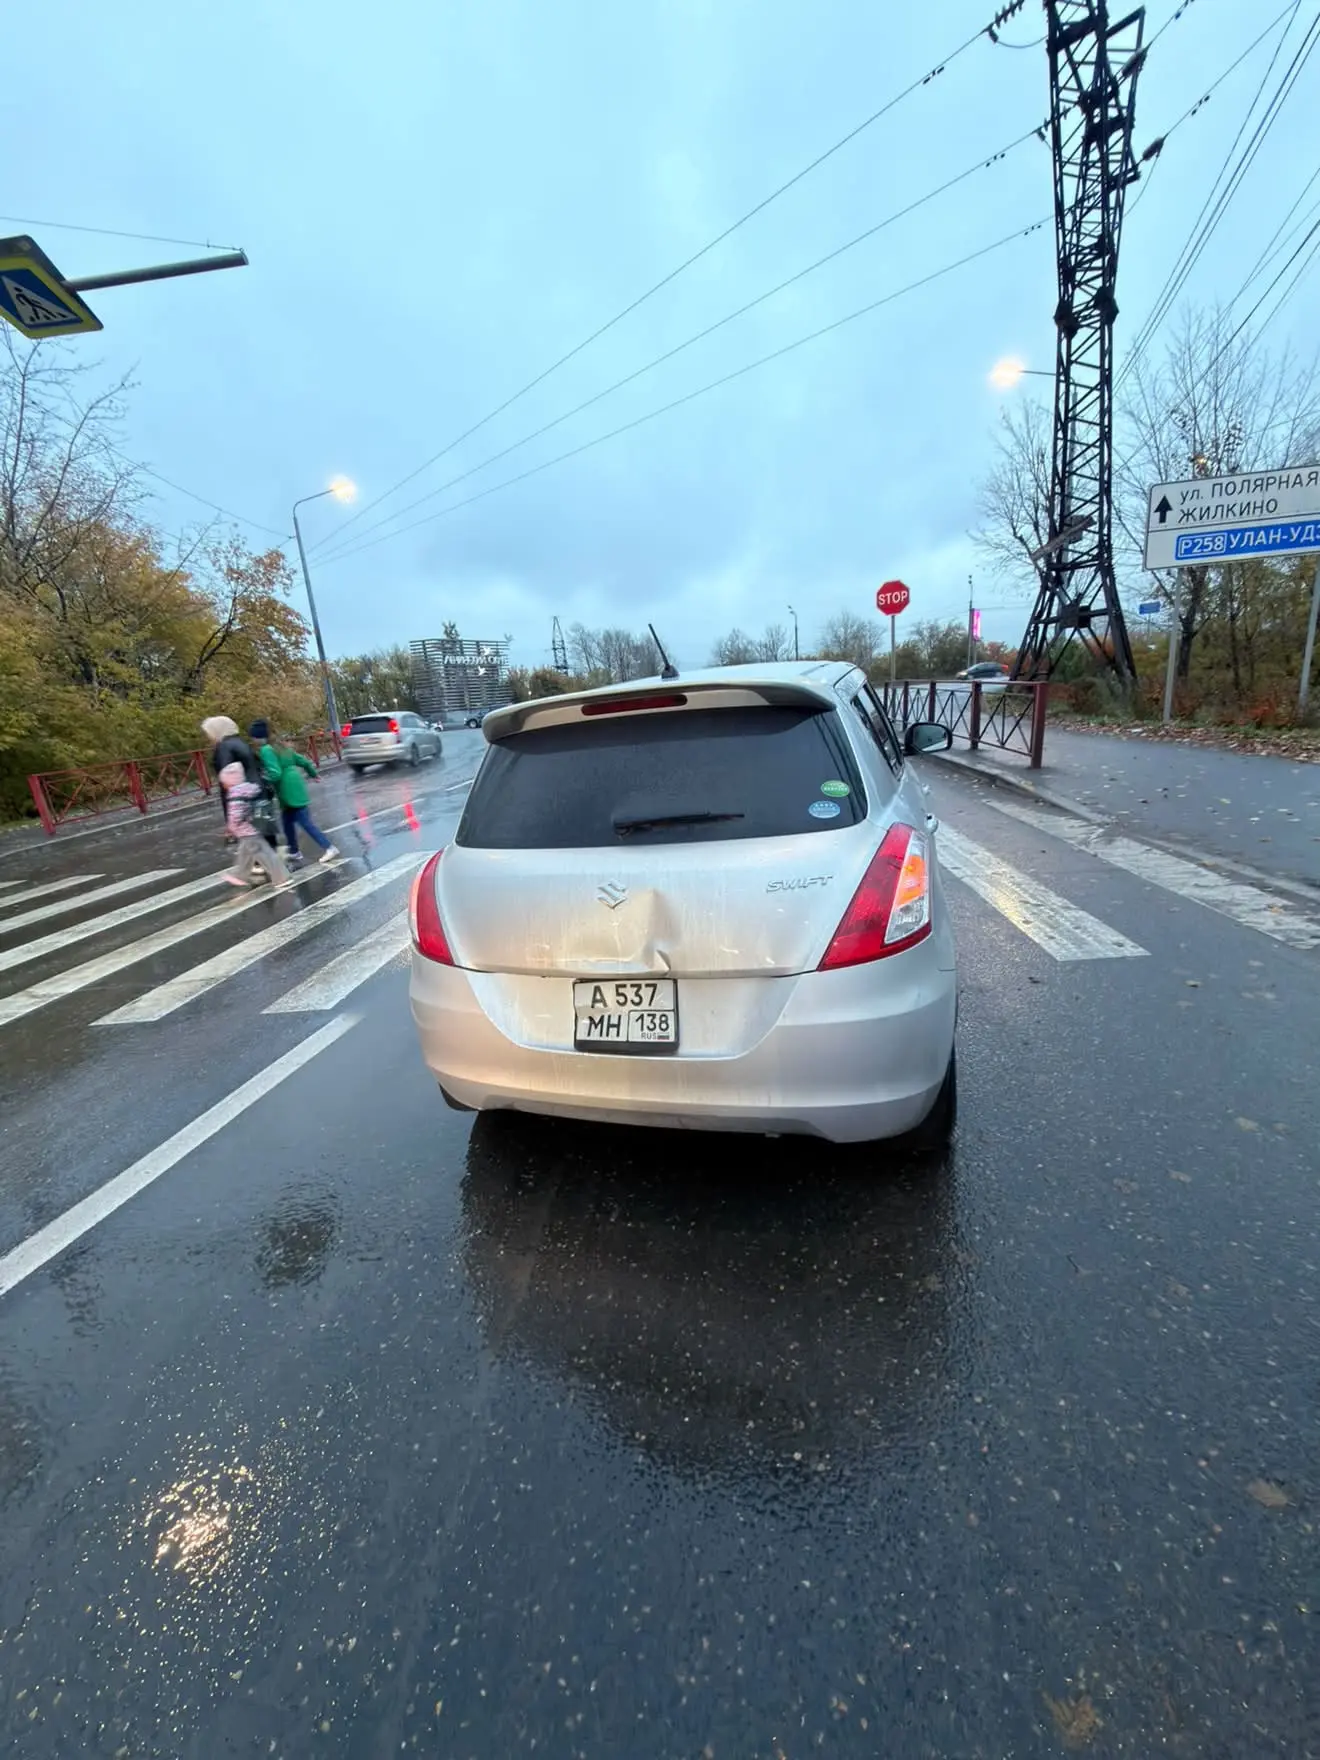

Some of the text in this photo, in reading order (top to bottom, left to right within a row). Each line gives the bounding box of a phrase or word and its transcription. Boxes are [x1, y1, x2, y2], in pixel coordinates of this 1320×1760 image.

[1180, 470, 1319, 505] ул. ПОЛЯРНАЯ
[1178, 498, 1278, 524] ЖИЛКИНО
[878, 590, 908, 605] STOP
[766, 874, 833, 893] SWIFT
[615, 983, 658, 1007] 537
[635, 1013, 670, 1032] 138
[641, 1032, 657, 1040] RUS
